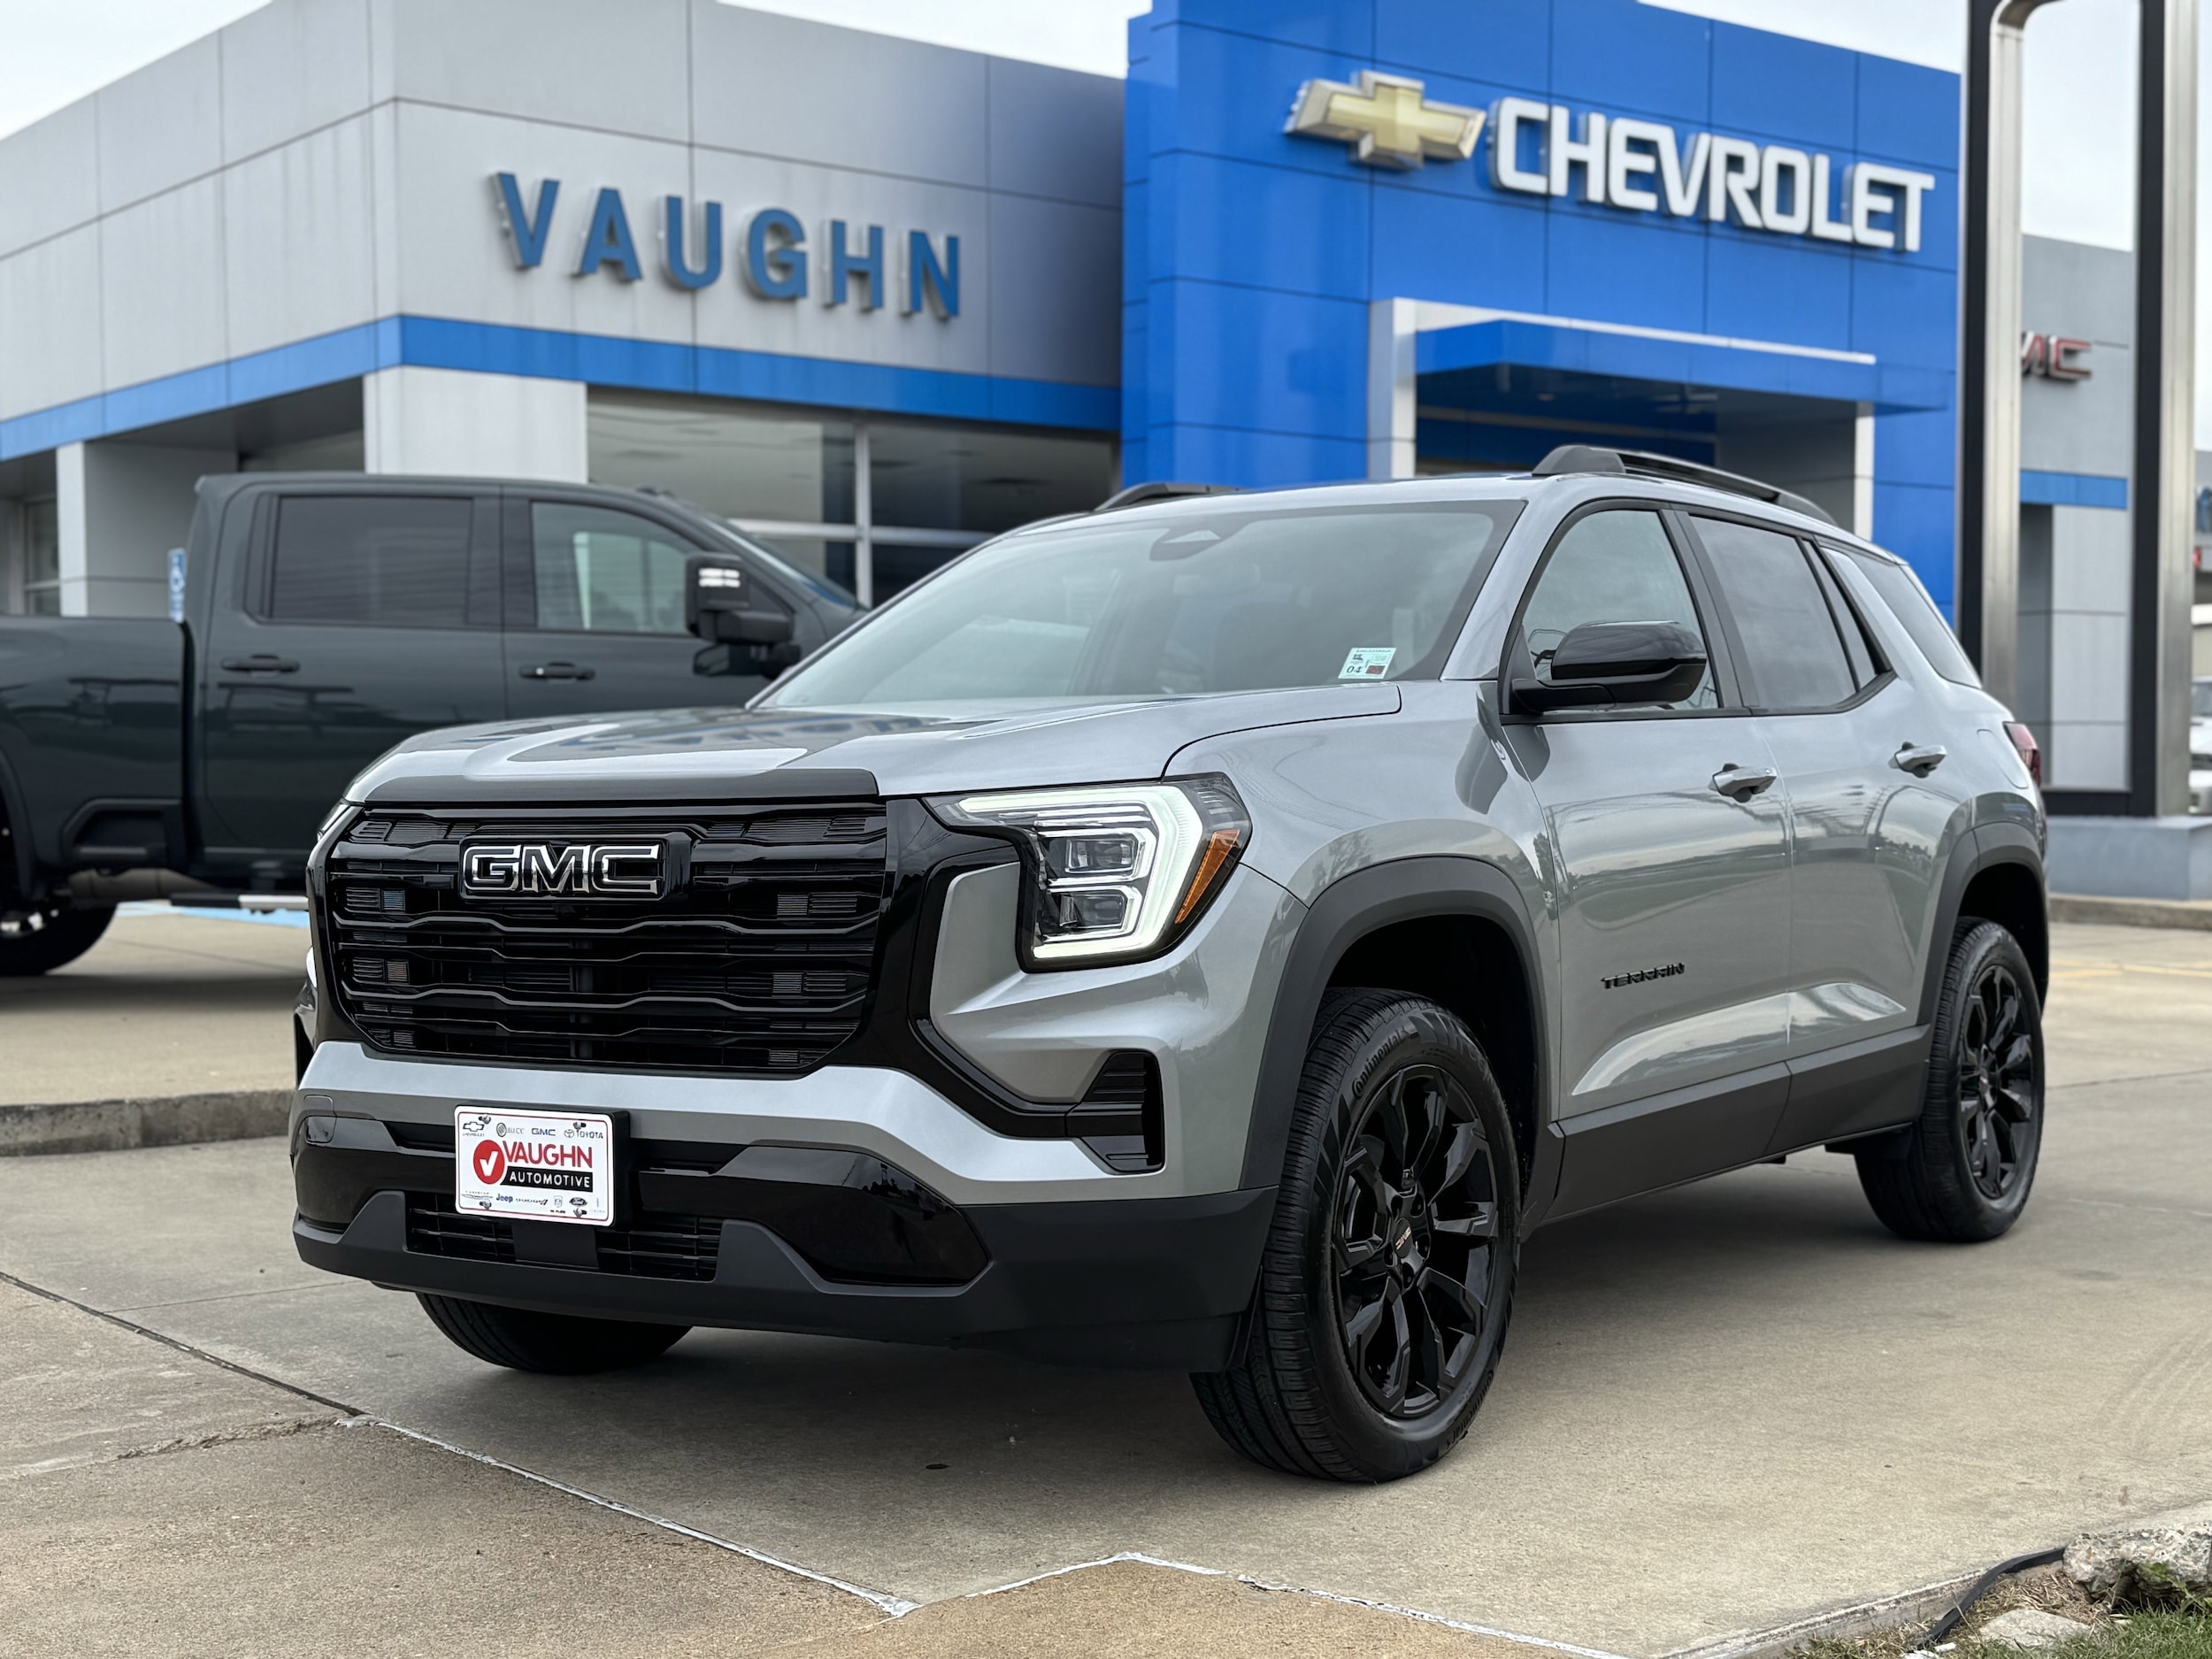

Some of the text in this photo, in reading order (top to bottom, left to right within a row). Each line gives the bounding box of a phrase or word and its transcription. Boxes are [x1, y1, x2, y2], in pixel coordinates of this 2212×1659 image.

[1492, 96, 1936, 253] CHEVROLET
[492, 171, 960, 319] VAUGHN
[463, 844, 661, 895] GMC
[1601, 962, 1686, 989] TERRAIN
[1351, 1029, 1402, 1099] Continental
[531, 1127, 557, 1137] GMC
[576, 1130, 603, 1139] TOYOTA
[502, 1140, 593, 1169] VAUGHN
[509, 1171, 591, 1188] AUTOMOTIVE
[495, 1193, 513, 1203] Jeep
